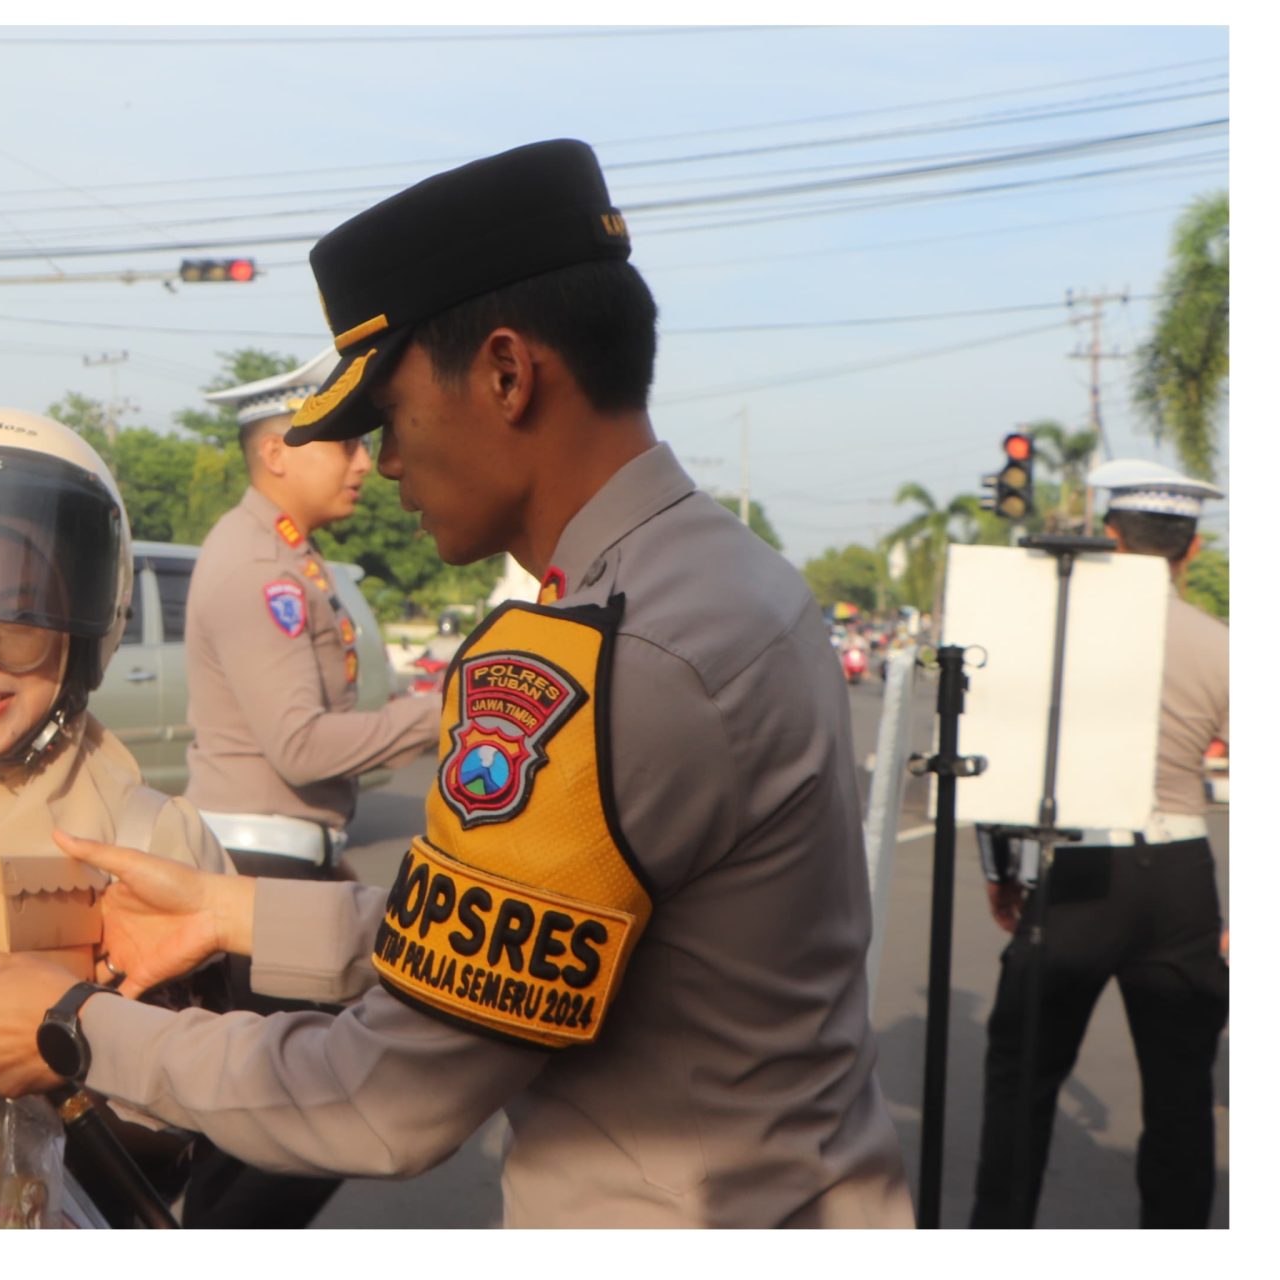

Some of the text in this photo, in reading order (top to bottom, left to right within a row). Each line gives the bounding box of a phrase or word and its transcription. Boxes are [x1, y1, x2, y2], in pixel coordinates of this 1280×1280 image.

[474, 664, 560, 701] POLRES
[488, 676, 542, 701] TUBAN
[472, 698, 538, 729] JAWA TIMUR
[401, 941, 457, 994] PRAJA
[455, 963, 544, 1020] SEMERU
[540, 988, 597, 1030] 2024
